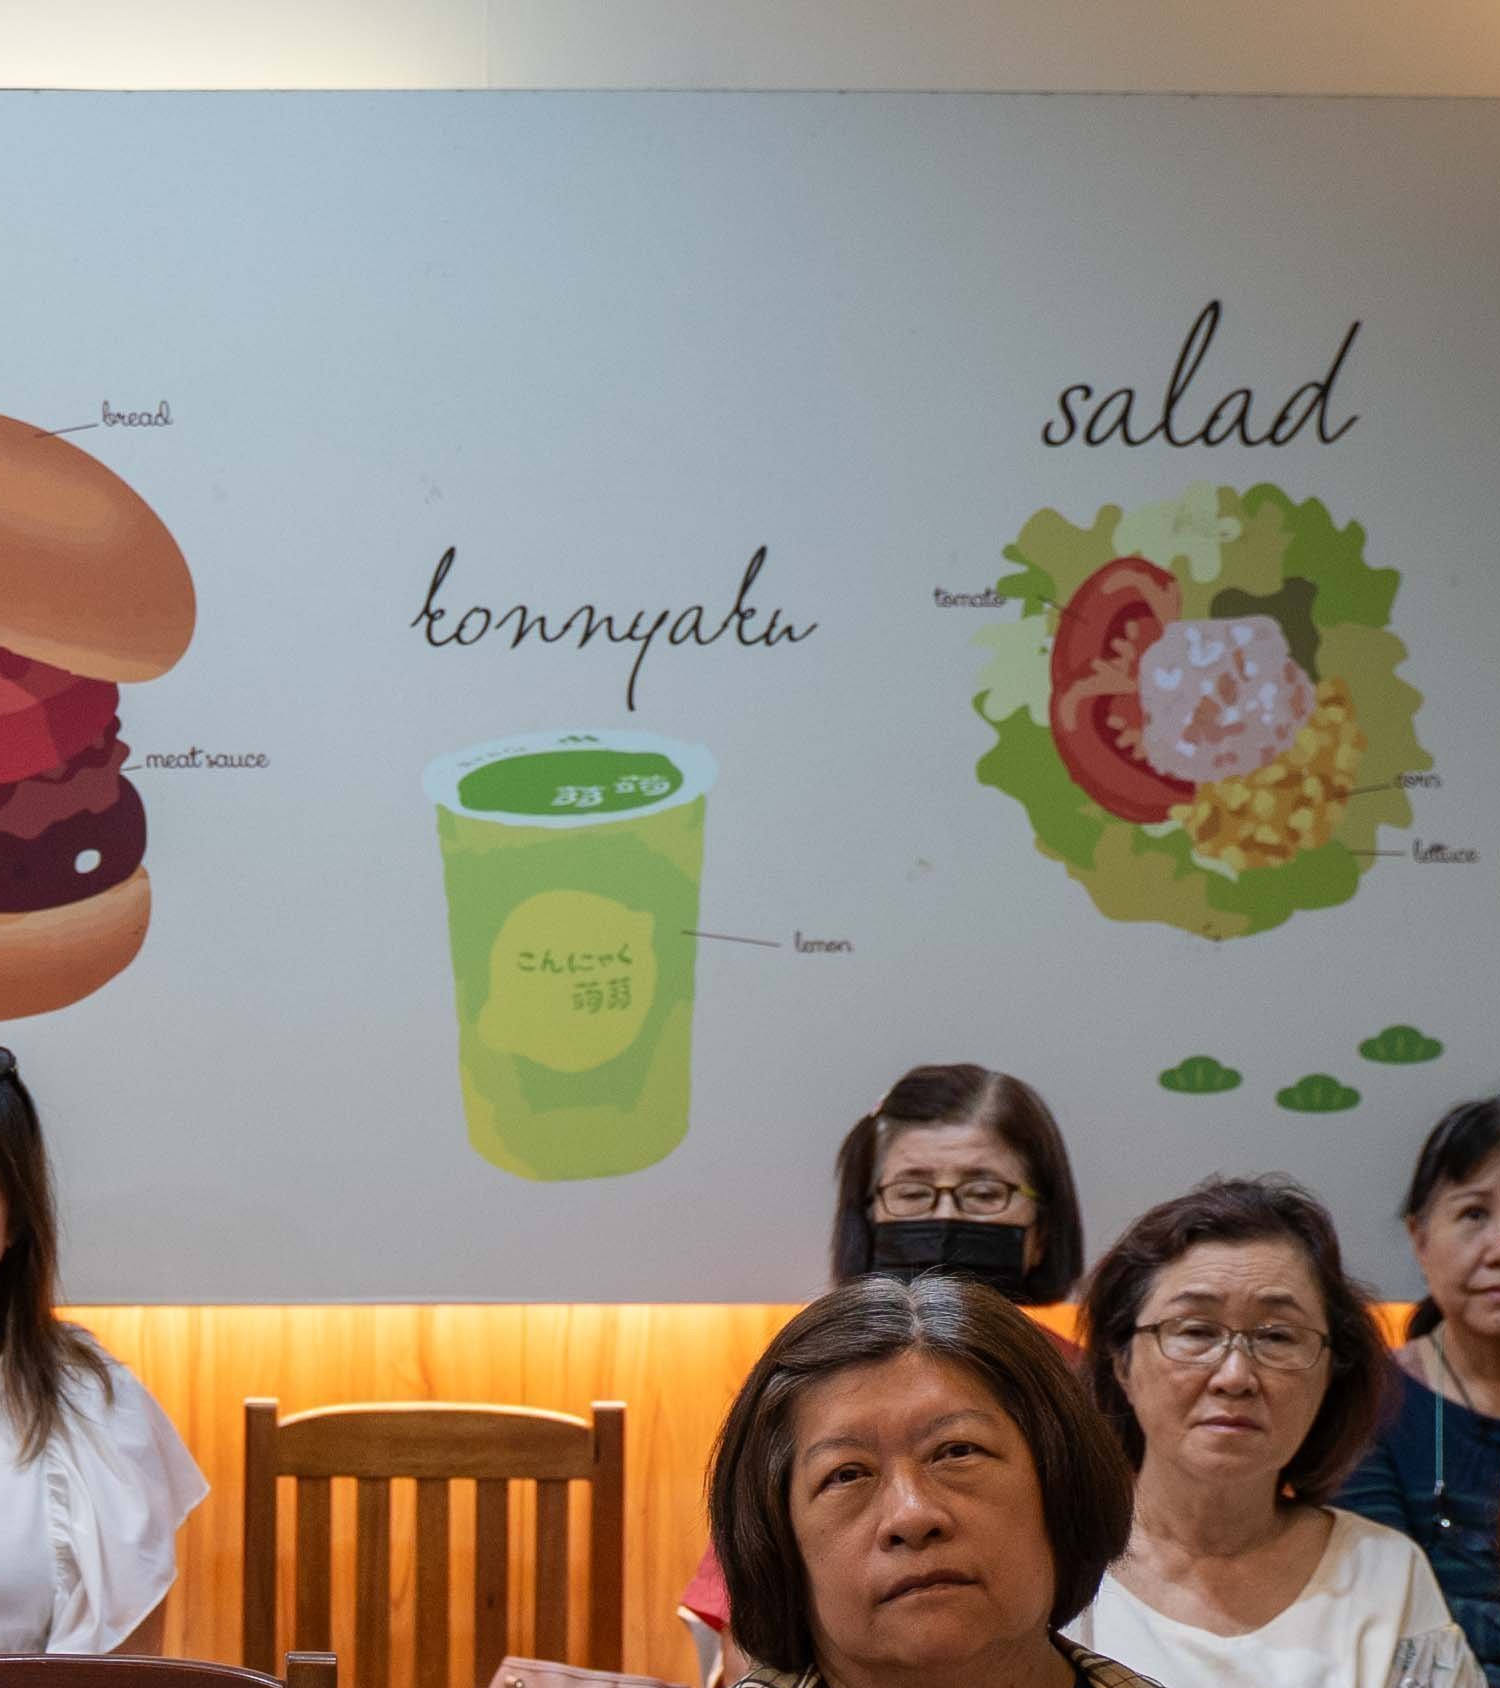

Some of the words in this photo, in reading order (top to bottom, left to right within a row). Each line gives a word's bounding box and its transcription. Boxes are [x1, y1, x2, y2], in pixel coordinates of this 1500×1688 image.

[1040, 298, 1362, 449] salad
[102, 400, 174, 428] bread
[409, 545, 819, 712] konnyaku
[146, 746, 204, 770] meat
[205, 751, 271, 770] sauce
[795, 930, 855, 953] lemon
[517, 944, 634, 975] こんにゃく
